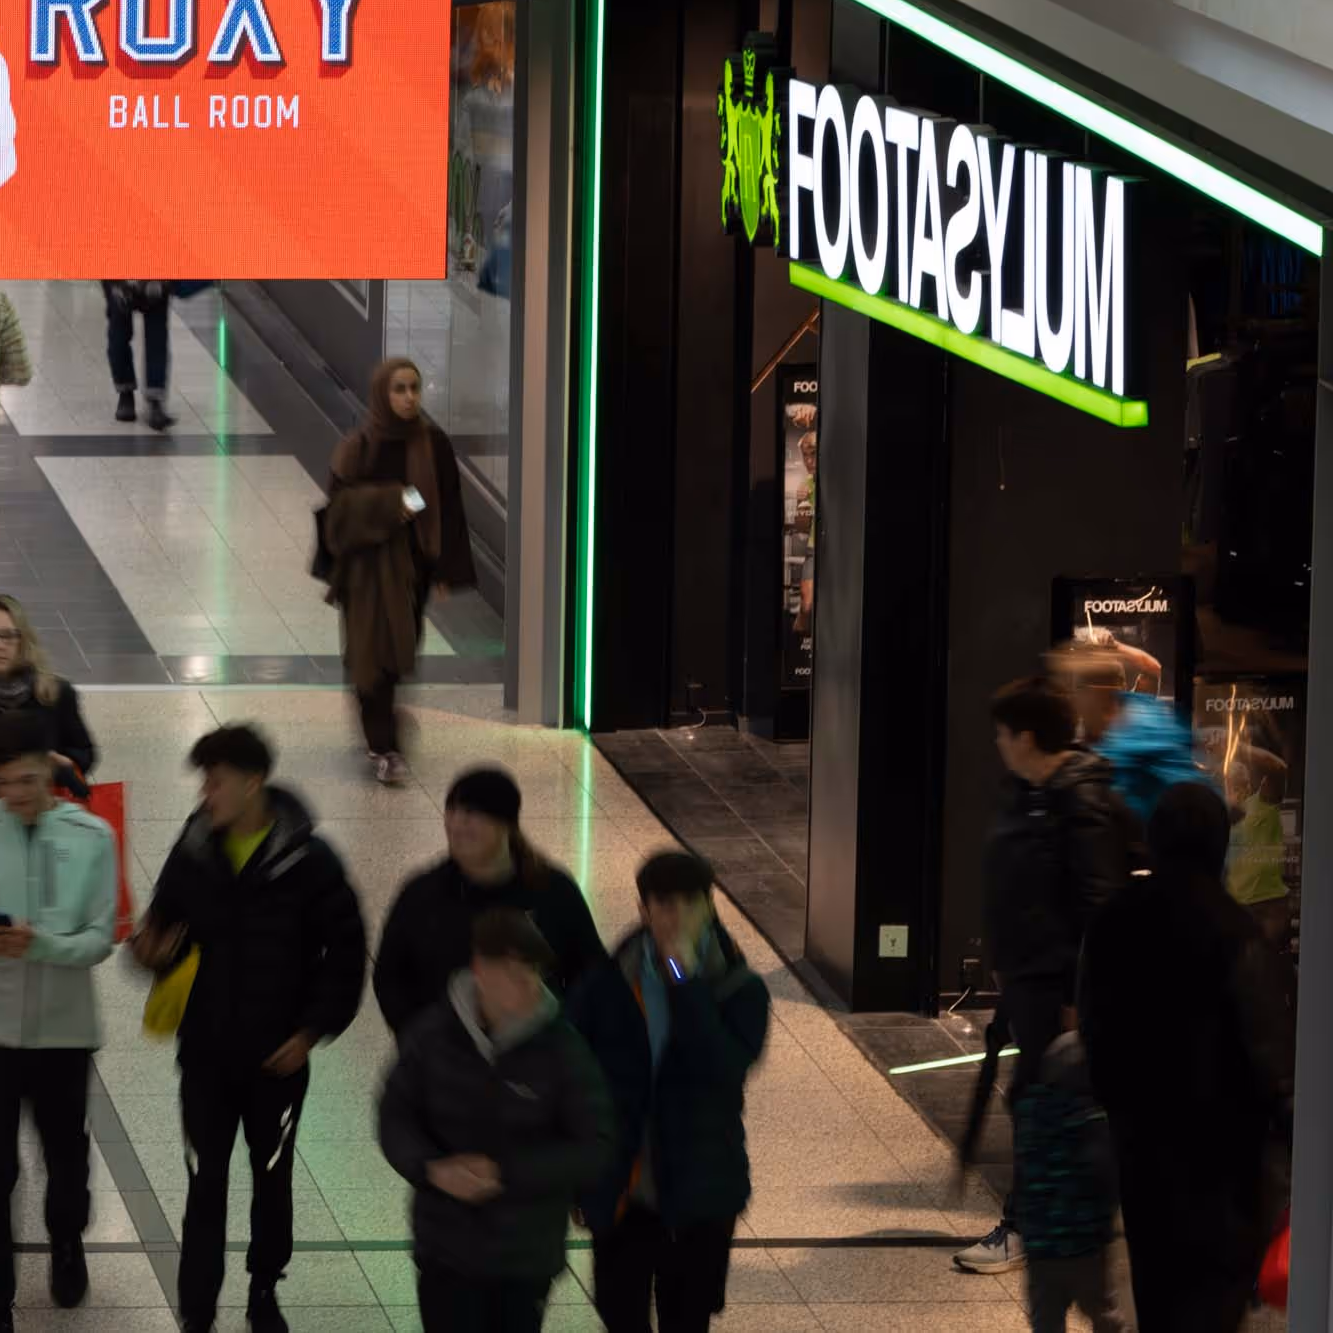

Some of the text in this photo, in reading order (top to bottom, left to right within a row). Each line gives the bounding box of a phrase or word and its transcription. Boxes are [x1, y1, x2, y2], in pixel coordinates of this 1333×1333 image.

[108, 95, 300, 129] BALL ROOM
[788, 78, 1126, 398] FOOTASYLUM
[1084, 599, 1168, 614] FOOTASYLUM
